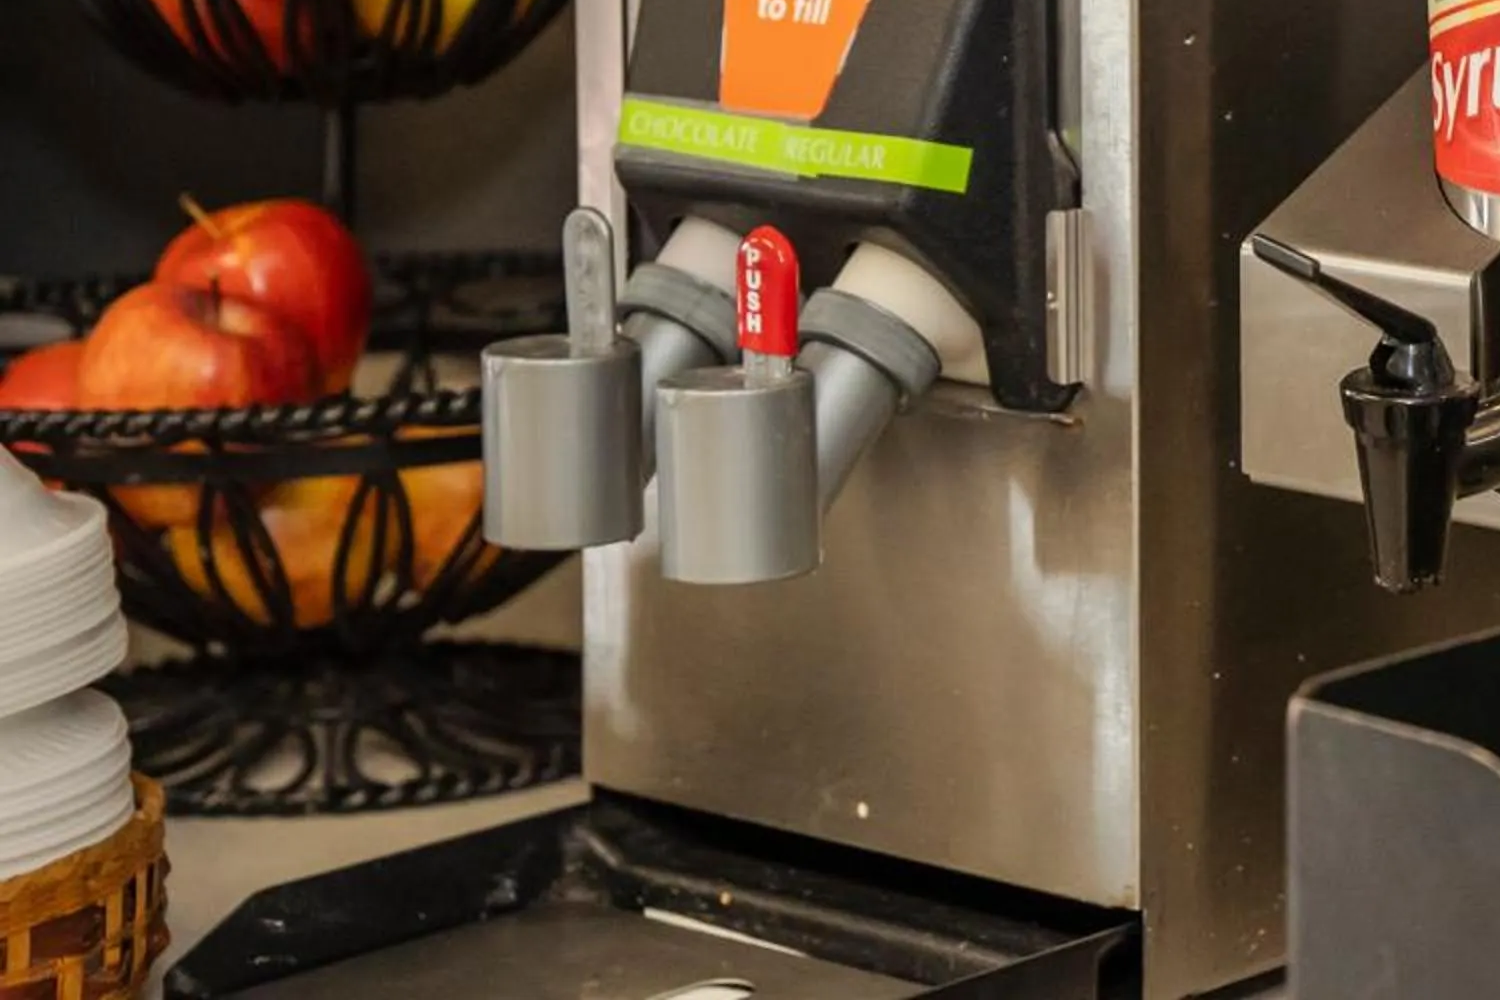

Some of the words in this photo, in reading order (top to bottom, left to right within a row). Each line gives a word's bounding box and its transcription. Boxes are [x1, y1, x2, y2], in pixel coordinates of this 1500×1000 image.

[628, 110, 760, 153] CHOCOLATE
[783, 135, 886, 169] REGULAR
[745, 247, 762, 334] PUSH
